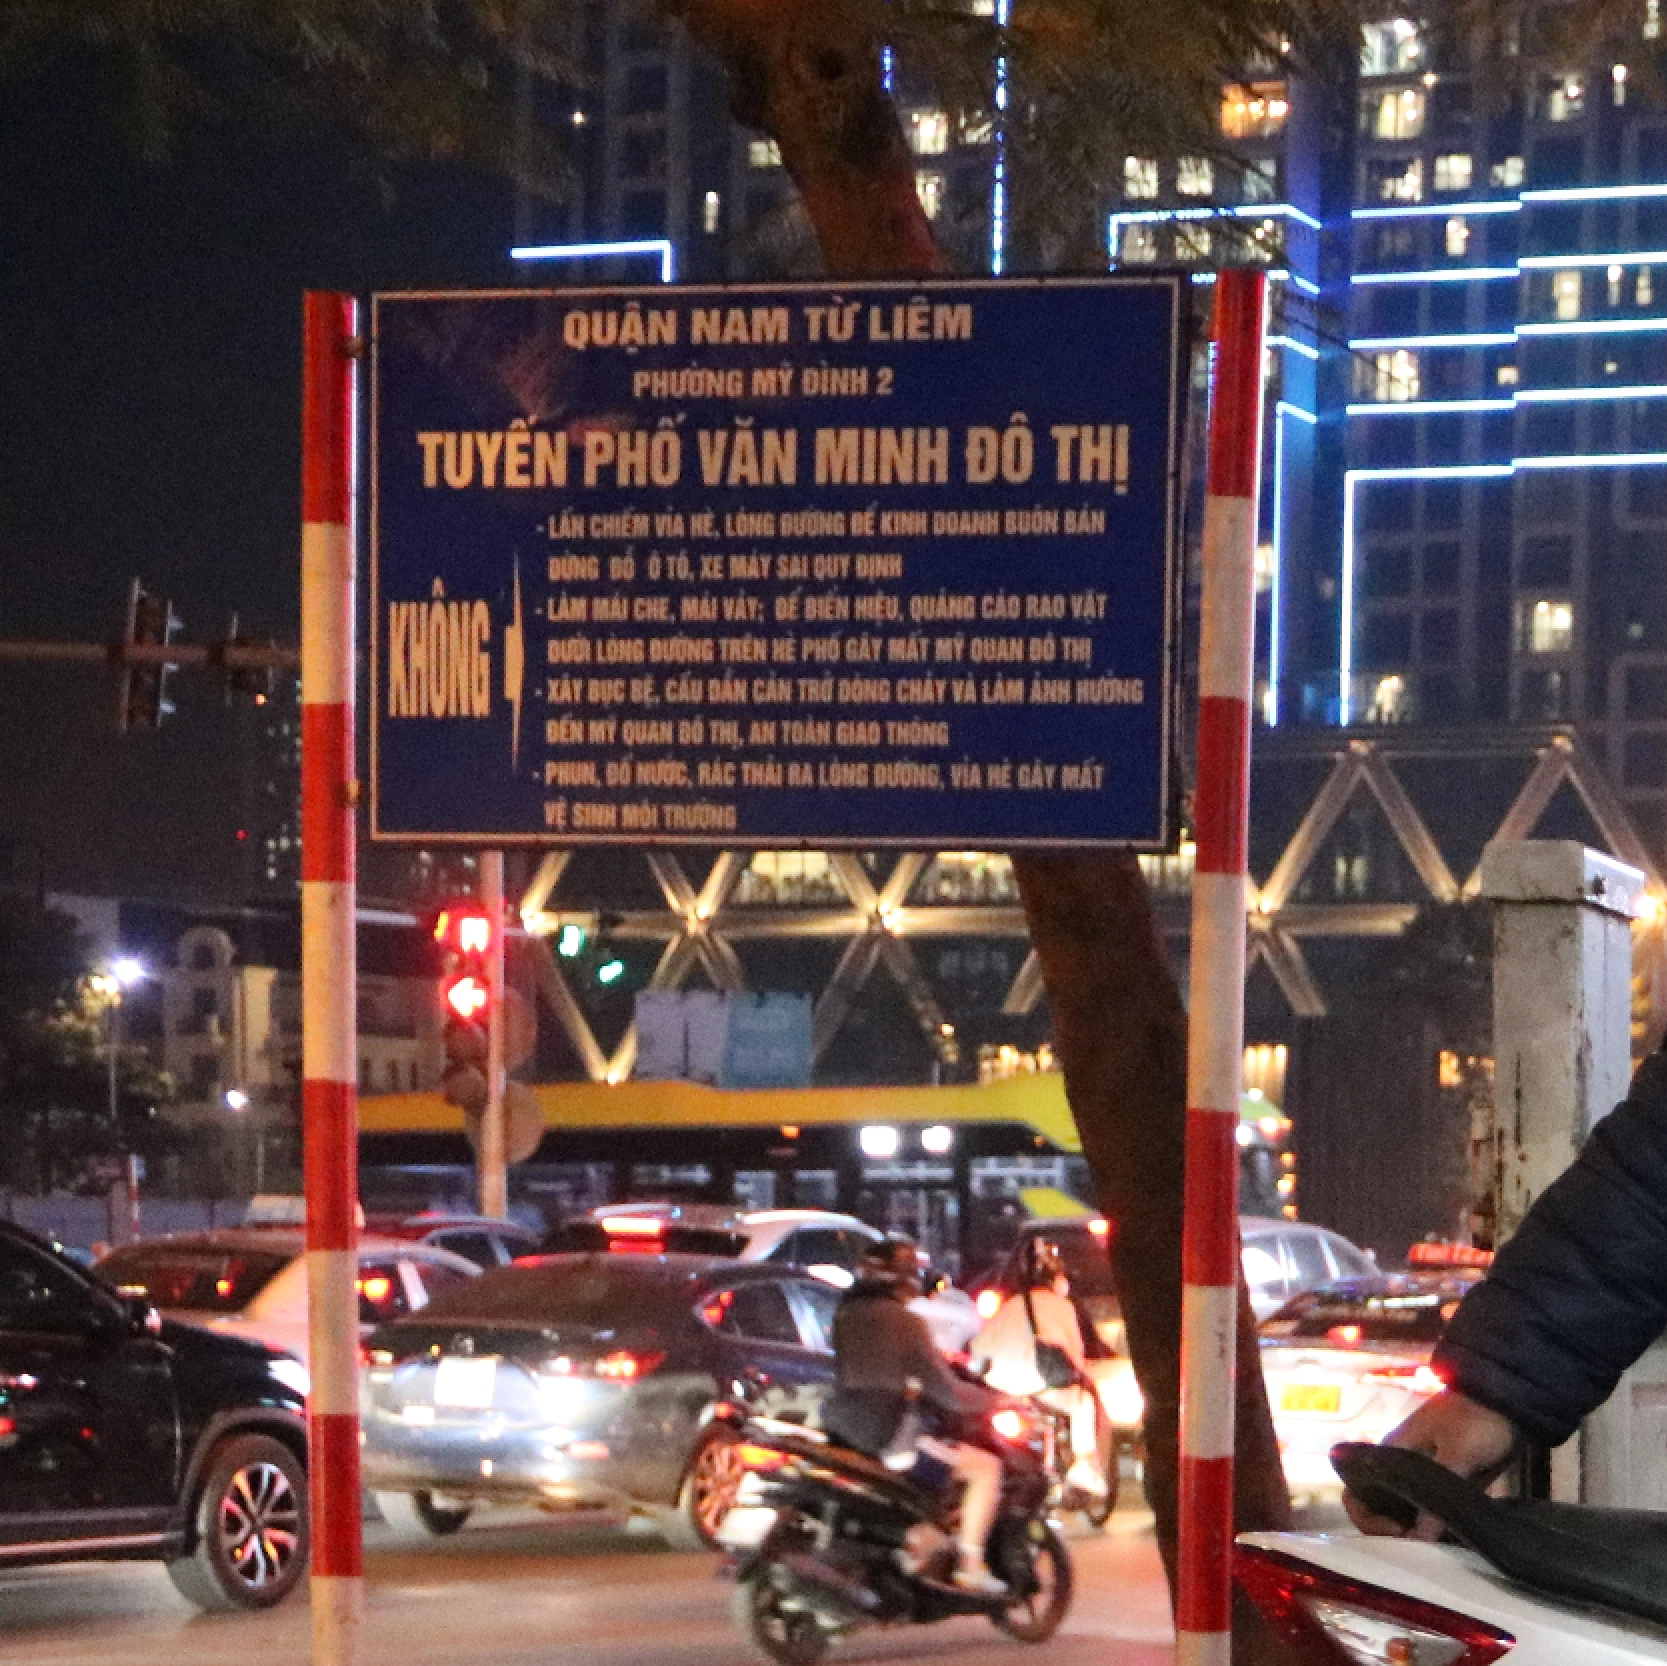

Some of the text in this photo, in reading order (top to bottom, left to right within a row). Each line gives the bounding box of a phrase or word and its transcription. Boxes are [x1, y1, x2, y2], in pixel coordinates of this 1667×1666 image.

[563, 295, 974, 354] QUẬN NAM TỪ LIÊM
[633, 358, 895, 398] PHƯỜNG MỸ ĐÌNH 2
[417, 410, 1132, 496] TUYẾN PHỐ VĂN MINH ĐÔ THỊ
[880, 510, 928, 537] KINH
[932, 509, 1000, 536] DOANH
[1063, 501, 1106, 535] BÁN
[701, 554, 725, 580] XE
[729, 548, 772, 580] MÁY
[777, 554, 809, 580] SAI
[813, 553, 850, 582] QUY
[980, 586, 1021, 620] CÁO
[1026, 594, 1066, 620] RAO
[388, 576, 491, 719] KHÔNG
[718, 631, 768, 662] TRÊN
[969, 637, 1025, 664] QUAN
[951, 671, 977, 704] VÀ
[622, 720, 675, 746] QUAN
[749, 720, 778, 745] AN
[836, 720, 882, 745] GIAO
[884, 714, 950, 746] THÔNG
[787, 761, 815, 788] RA
[571, 802, 618, 830] SINH
